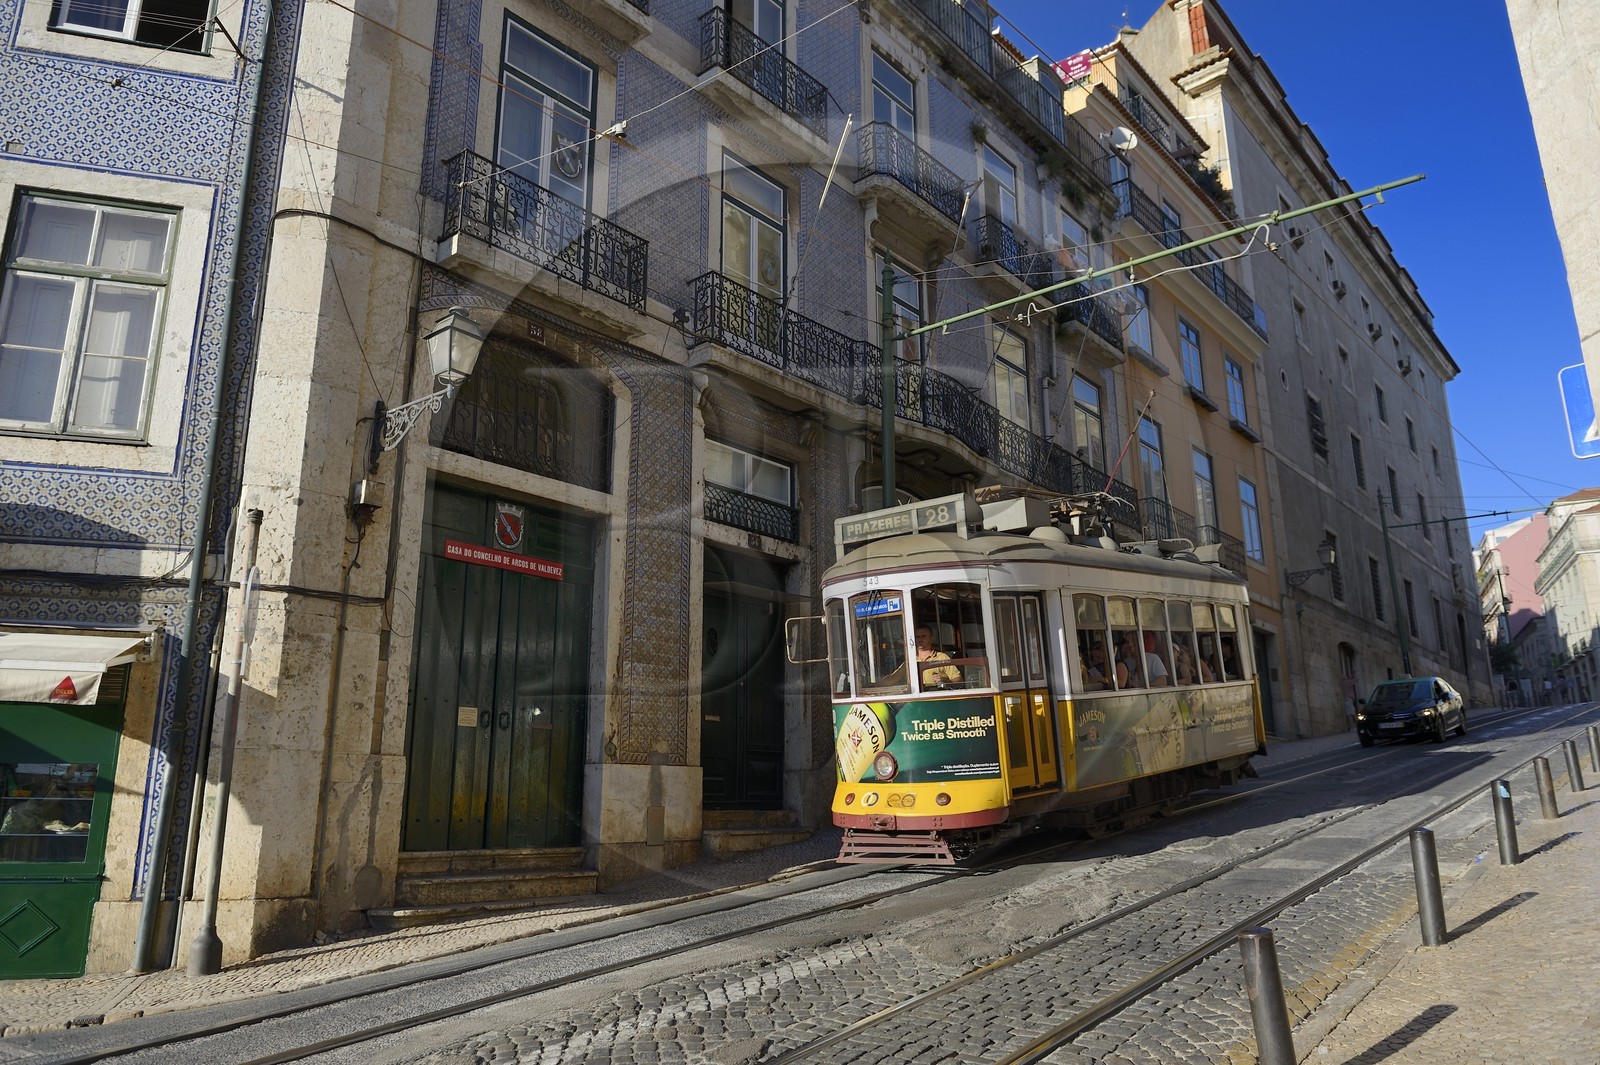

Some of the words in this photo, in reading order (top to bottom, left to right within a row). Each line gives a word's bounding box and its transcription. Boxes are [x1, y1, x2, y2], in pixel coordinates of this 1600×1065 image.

[847, 515, 910, 536] PRAZERES
[925, 505, 949, 527] 28
[447, 545, 463, 556] CASA
[463, 548, 472, 557] DO
[473, 550, 503, 563] CONCELHO
[503, 556, 510, 565] DE
[511, 558, 529, 569] ARCOS
[529, 562, 537, 571] DE
[537, 563, 563, 576] VALDEVEZ
[863, 575, 879, 587] 543
[911, 719, 945, 733] Triple
[947, 715, 995, 730] Distilled
[1078, 709, 1106, 728] JAMESON
[849, 707, 880, 754] JAMESON
[901, 731, 930, 741] Twice
[932, 732, 944, 740] as
